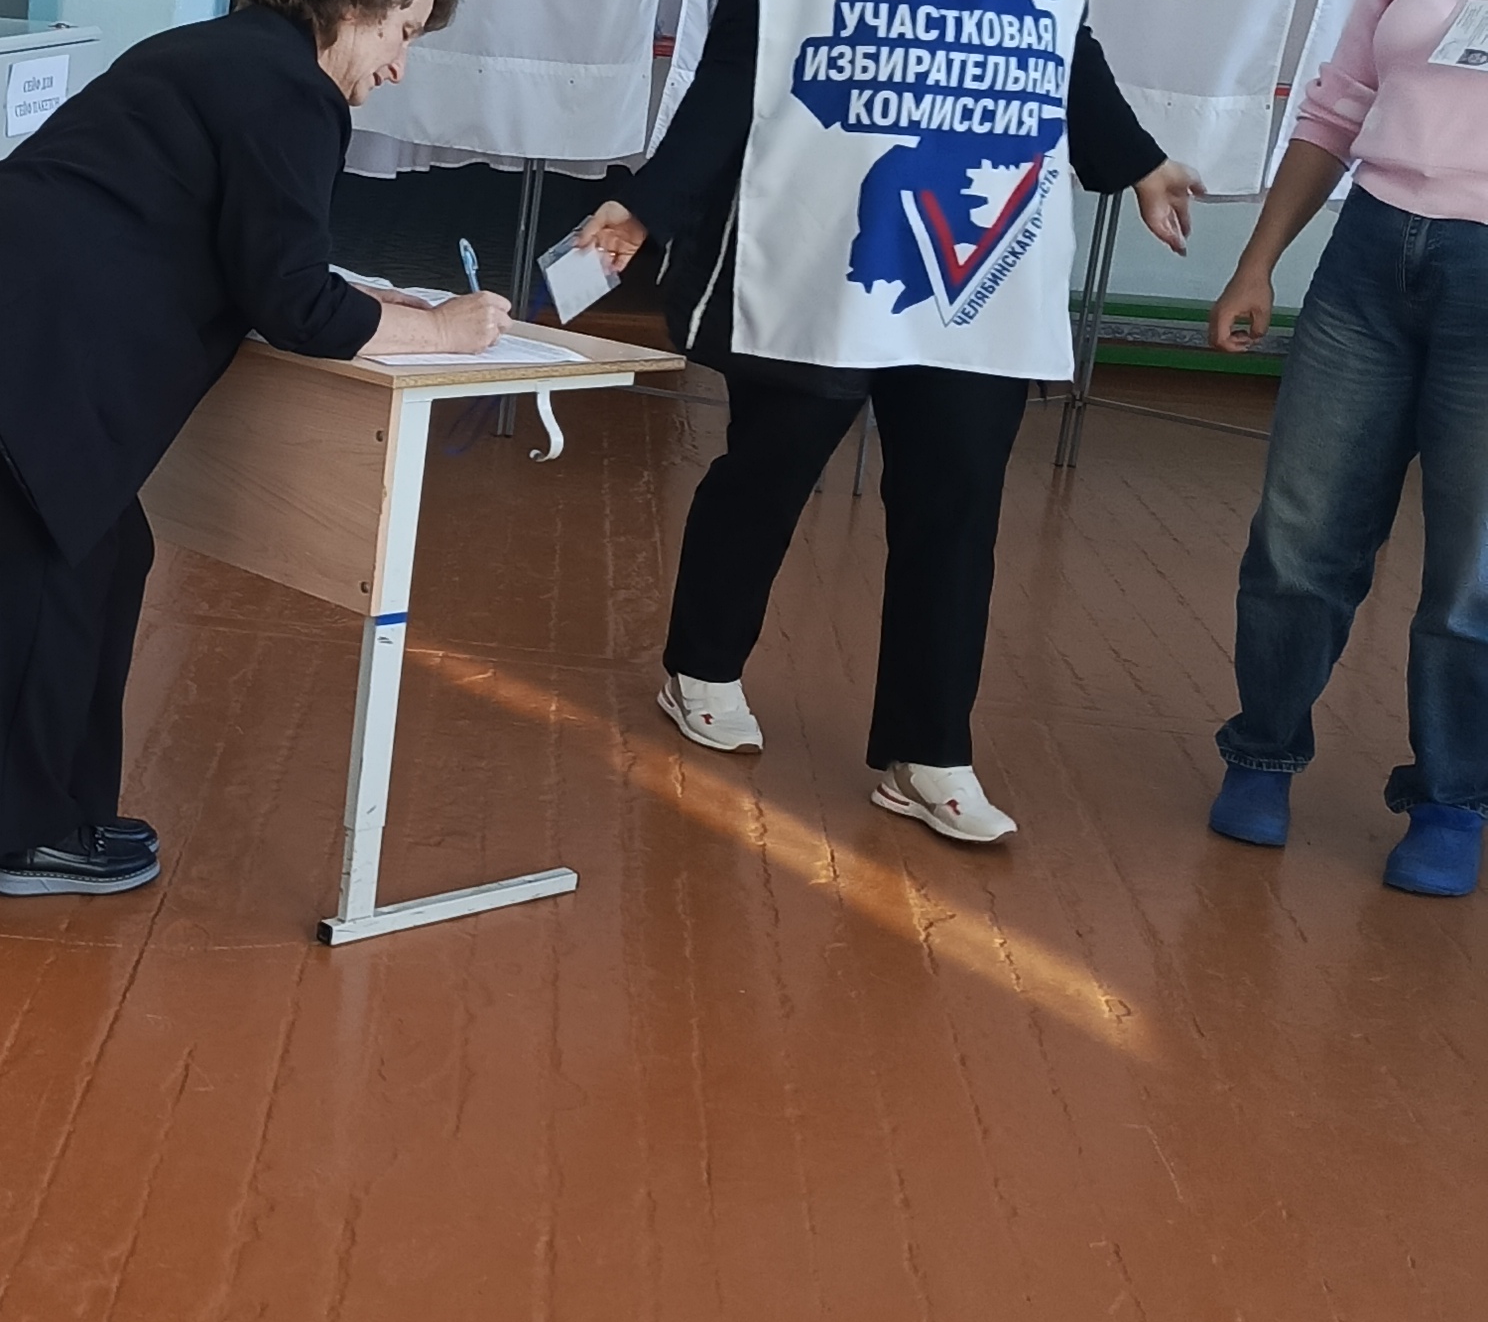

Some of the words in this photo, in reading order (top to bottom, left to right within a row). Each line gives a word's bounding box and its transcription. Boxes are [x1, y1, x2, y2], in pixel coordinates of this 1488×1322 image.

[840, 1, 1054, 53] УЧАСТКОВАЯ
[848, 89, 1040, 137] КОМИССИЯ
[952, 230, 1038, 327] ЧЕЛЯБИНСКАЯ
